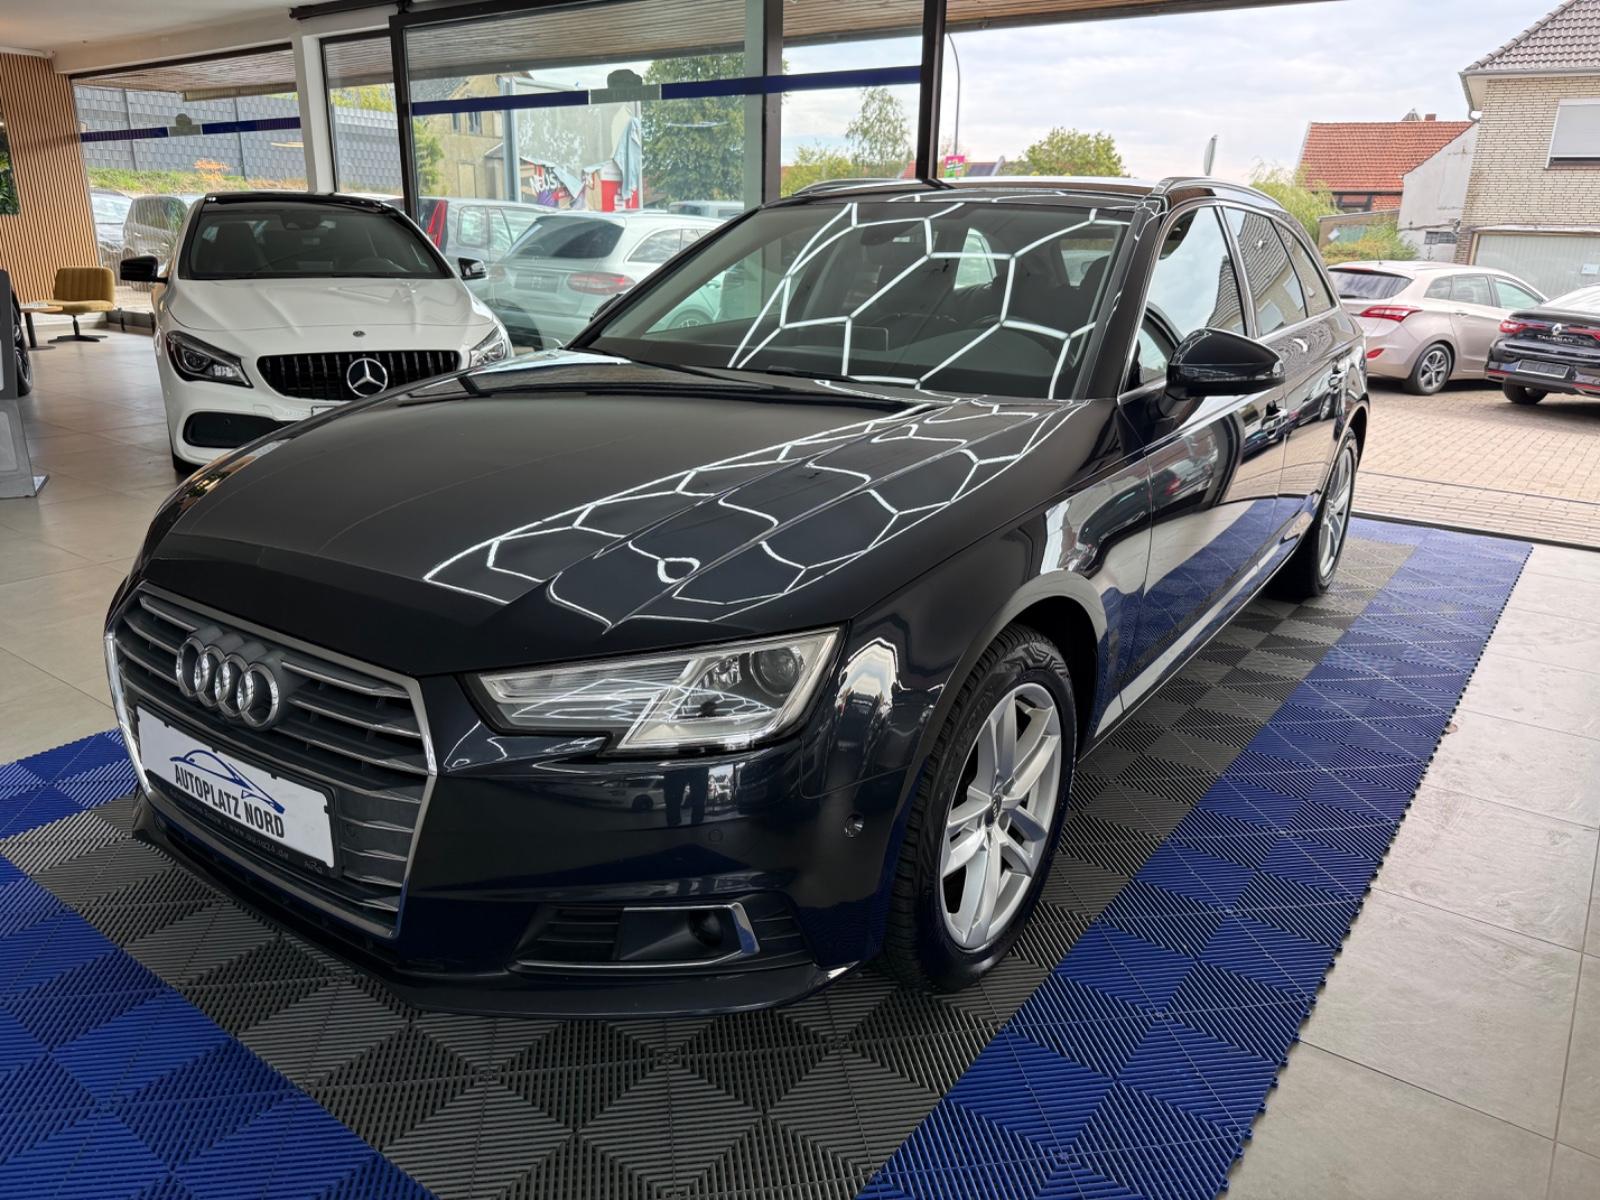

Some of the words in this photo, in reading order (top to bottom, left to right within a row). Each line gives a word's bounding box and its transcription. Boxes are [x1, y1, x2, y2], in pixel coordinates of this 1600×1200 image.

[1537, 334, 1574, 343] TALISMAN
[174, 764, 241, 819] AUTOPLATZ
[244, 802, 285, 838] NORD
